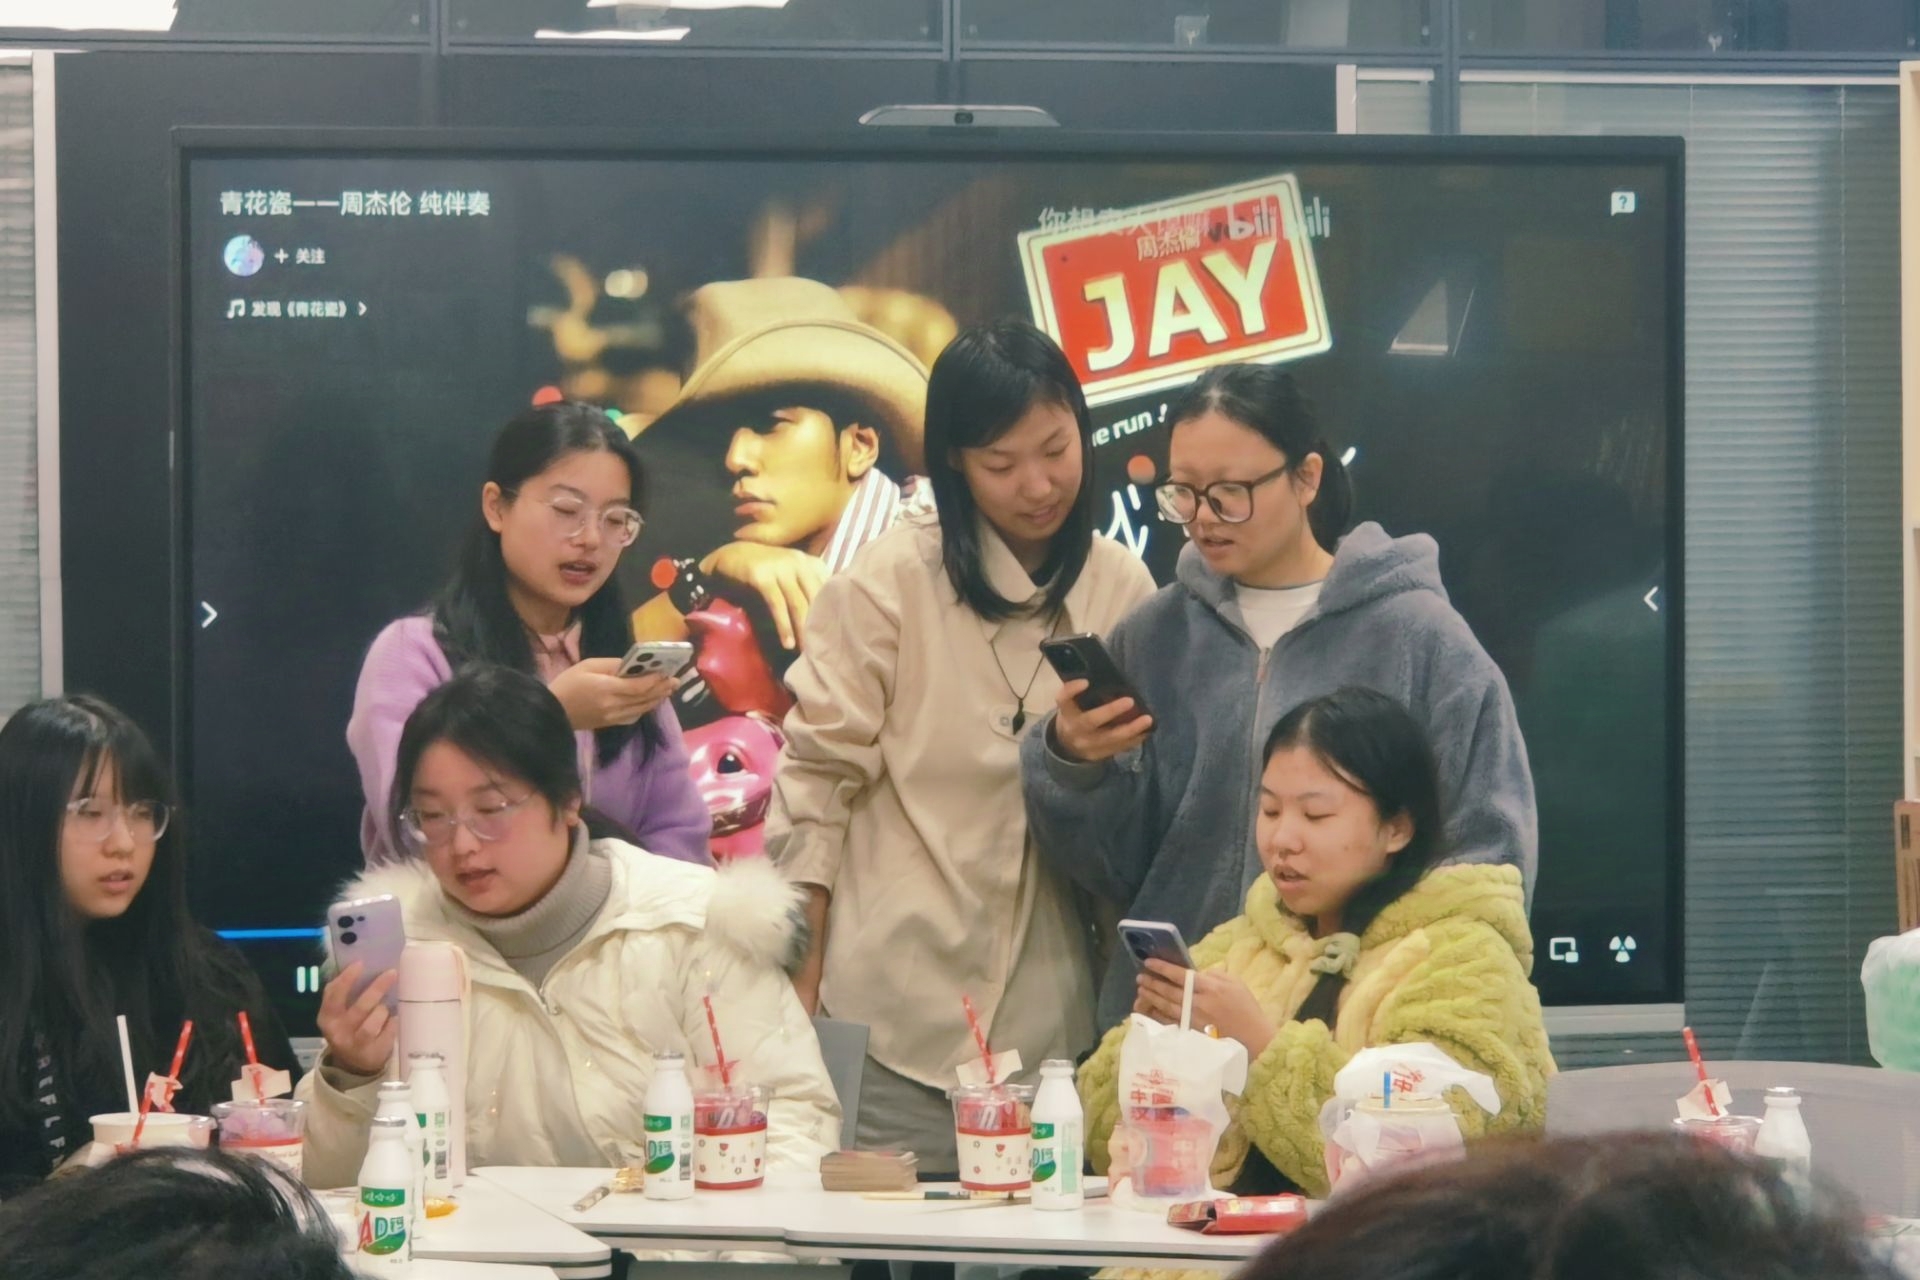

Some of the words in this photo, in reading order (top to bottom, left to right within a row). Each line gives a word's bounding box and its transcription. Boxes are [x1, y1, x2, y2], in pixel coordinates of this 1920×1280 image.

[220, 190, 412, 216] 青花瓷——周杰伦
[419, 190, 491, 216] 纯伴奏
[296, 248, 326, 264] 关注
[1083, 240, 1278, 372] JAY
